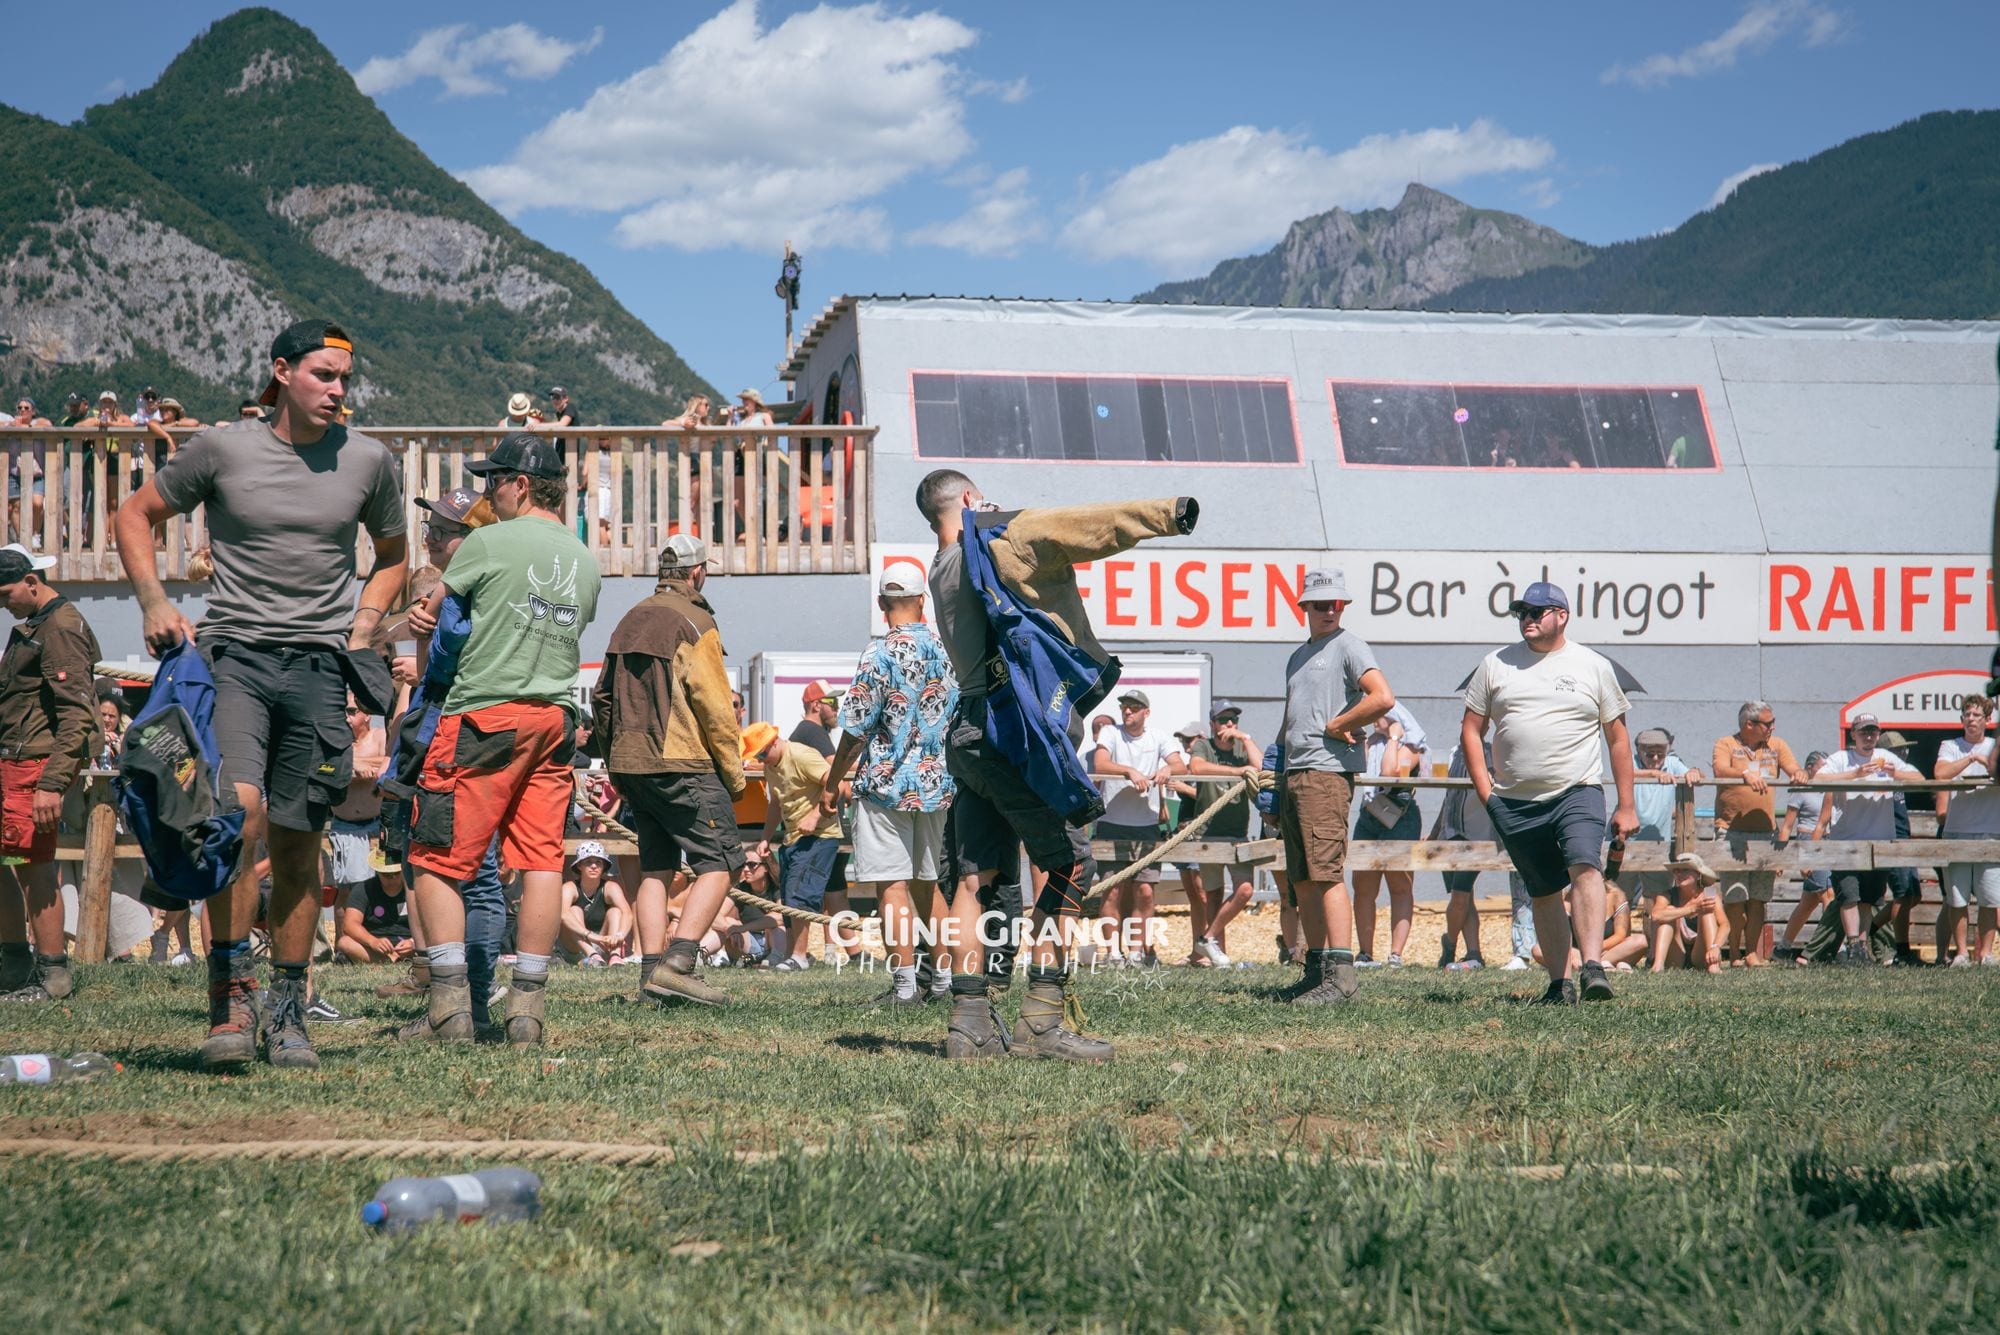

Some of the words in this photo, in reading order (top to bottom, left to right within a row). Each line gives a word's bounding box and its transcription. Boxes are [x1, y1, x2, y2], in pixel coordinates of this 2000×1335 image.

[1371, 561, 1465, 618] Bar
[1488, 560, 1516, 617] à
[1892, 693, 1914, 710] LE
